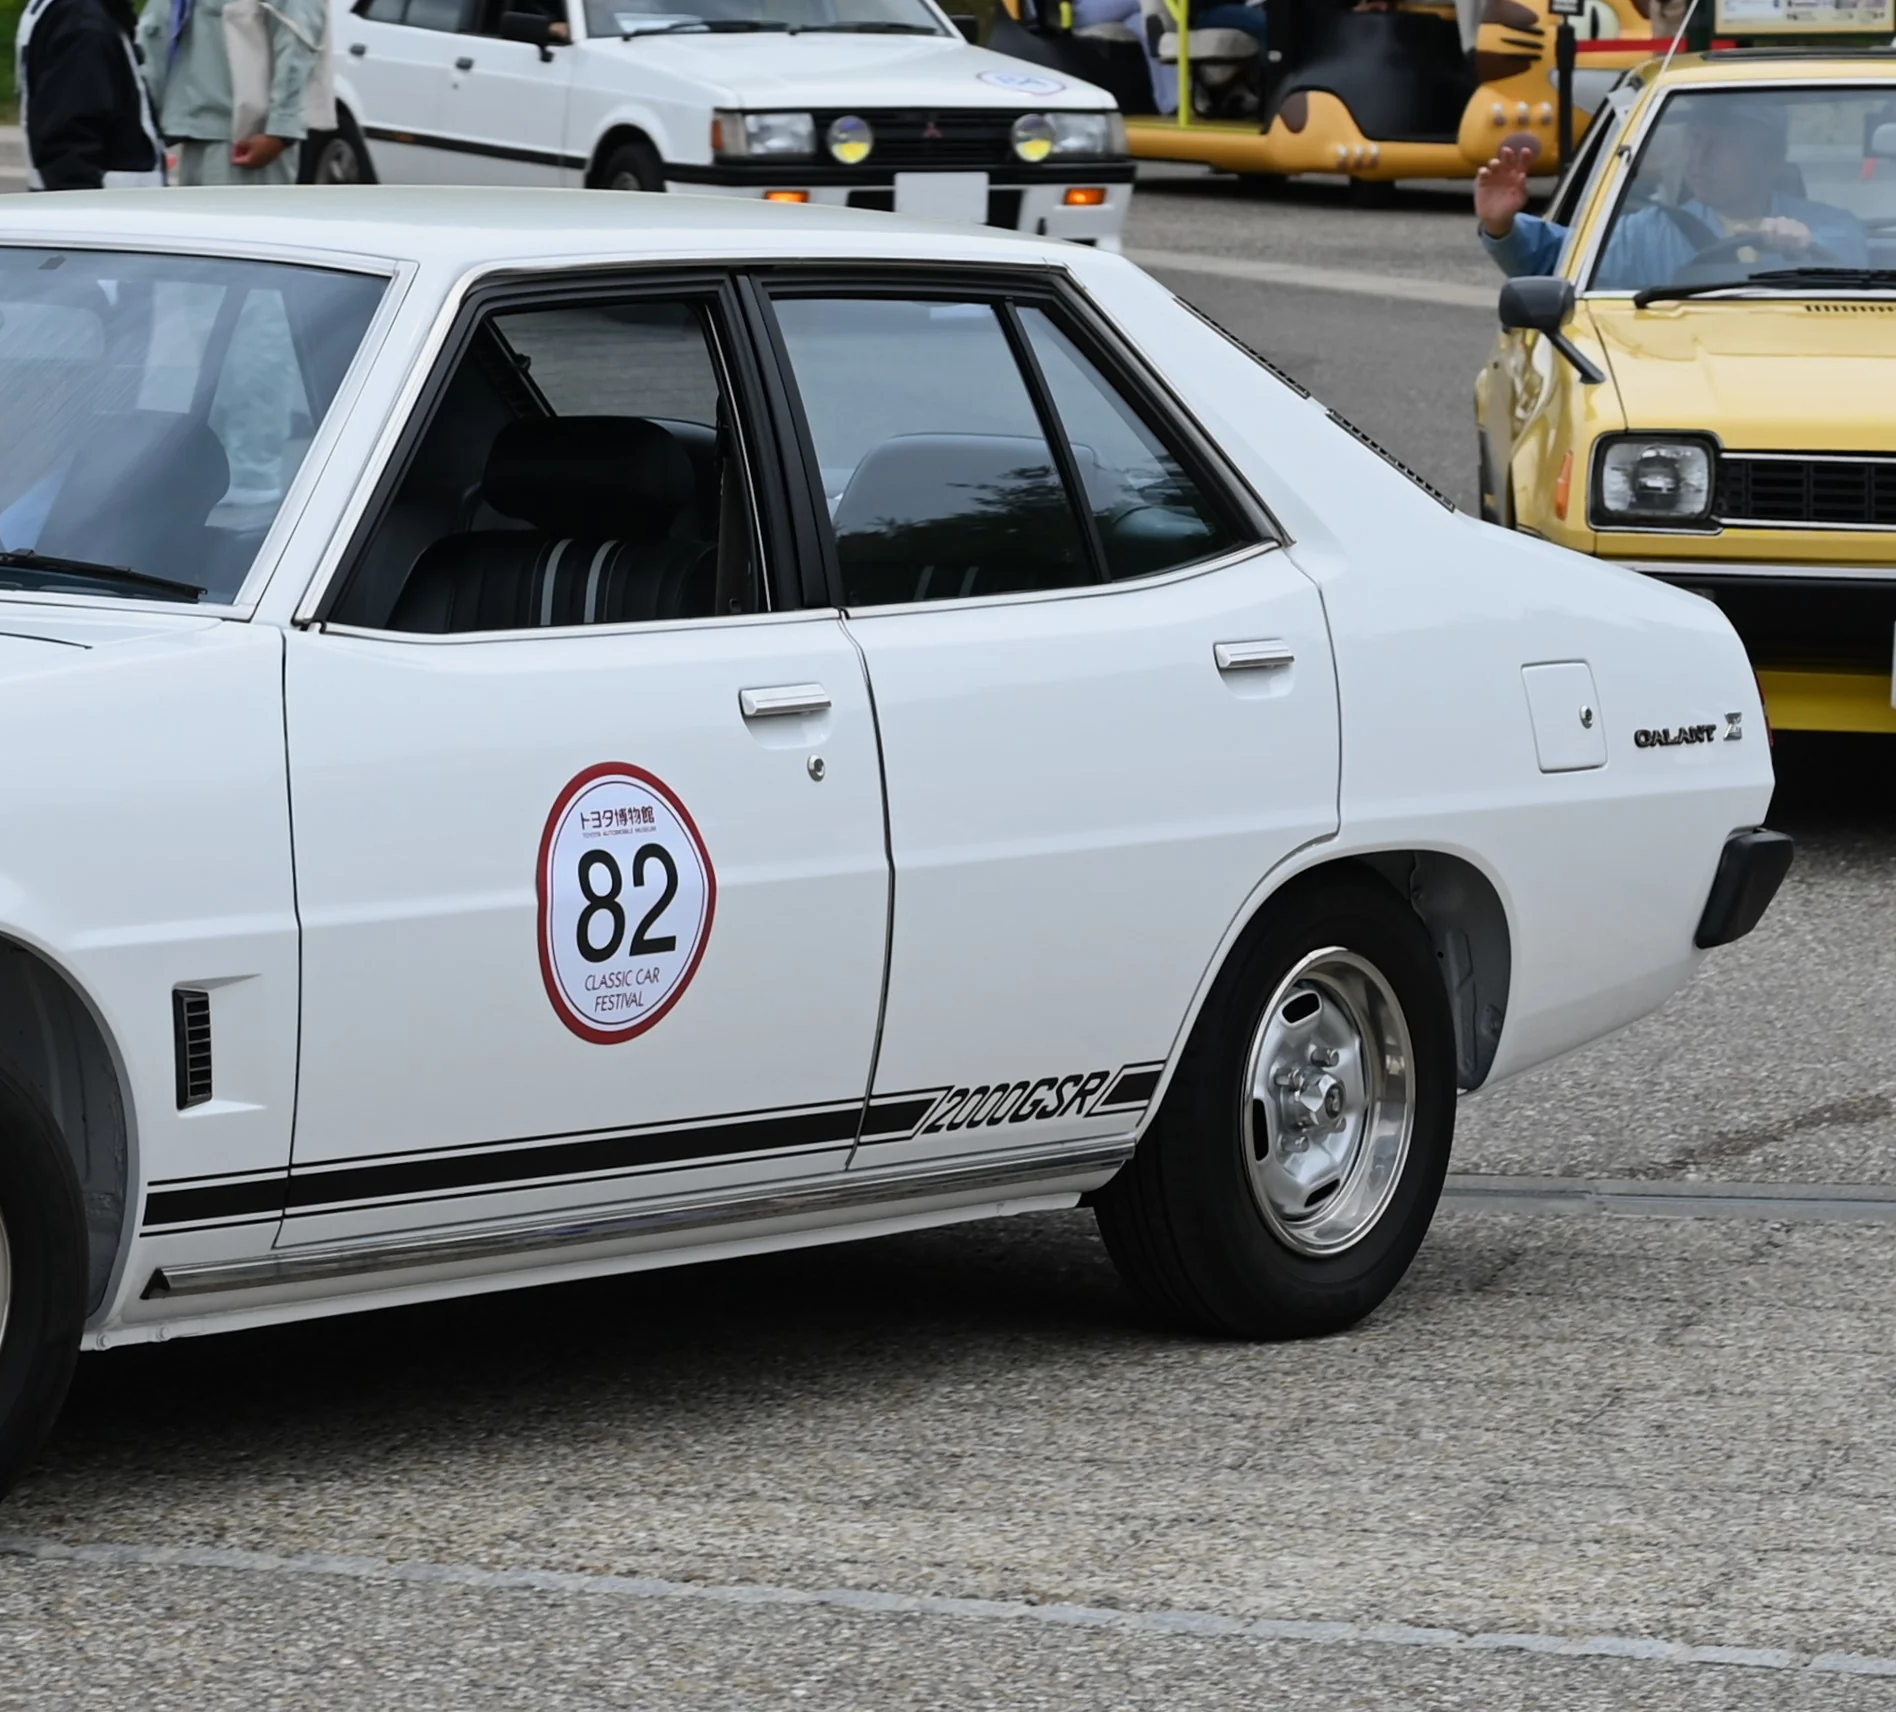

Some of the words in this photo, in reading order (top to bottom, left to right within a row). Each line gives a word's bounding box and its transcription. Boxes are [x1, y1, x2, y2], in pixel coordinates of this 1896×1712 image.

[1633, 723, 1717, 749] GALANT
[579, 805, 656, 831] トヨタ博物館
[575, 842, 679, 964] 82
[584, 968, 633, 992] CLASSIC
[635, 966, 660, 986] CAR
[594, 990, 645, 1013] FESTIVAL
[920, 1069, 1111, 1136] 2000GSR
